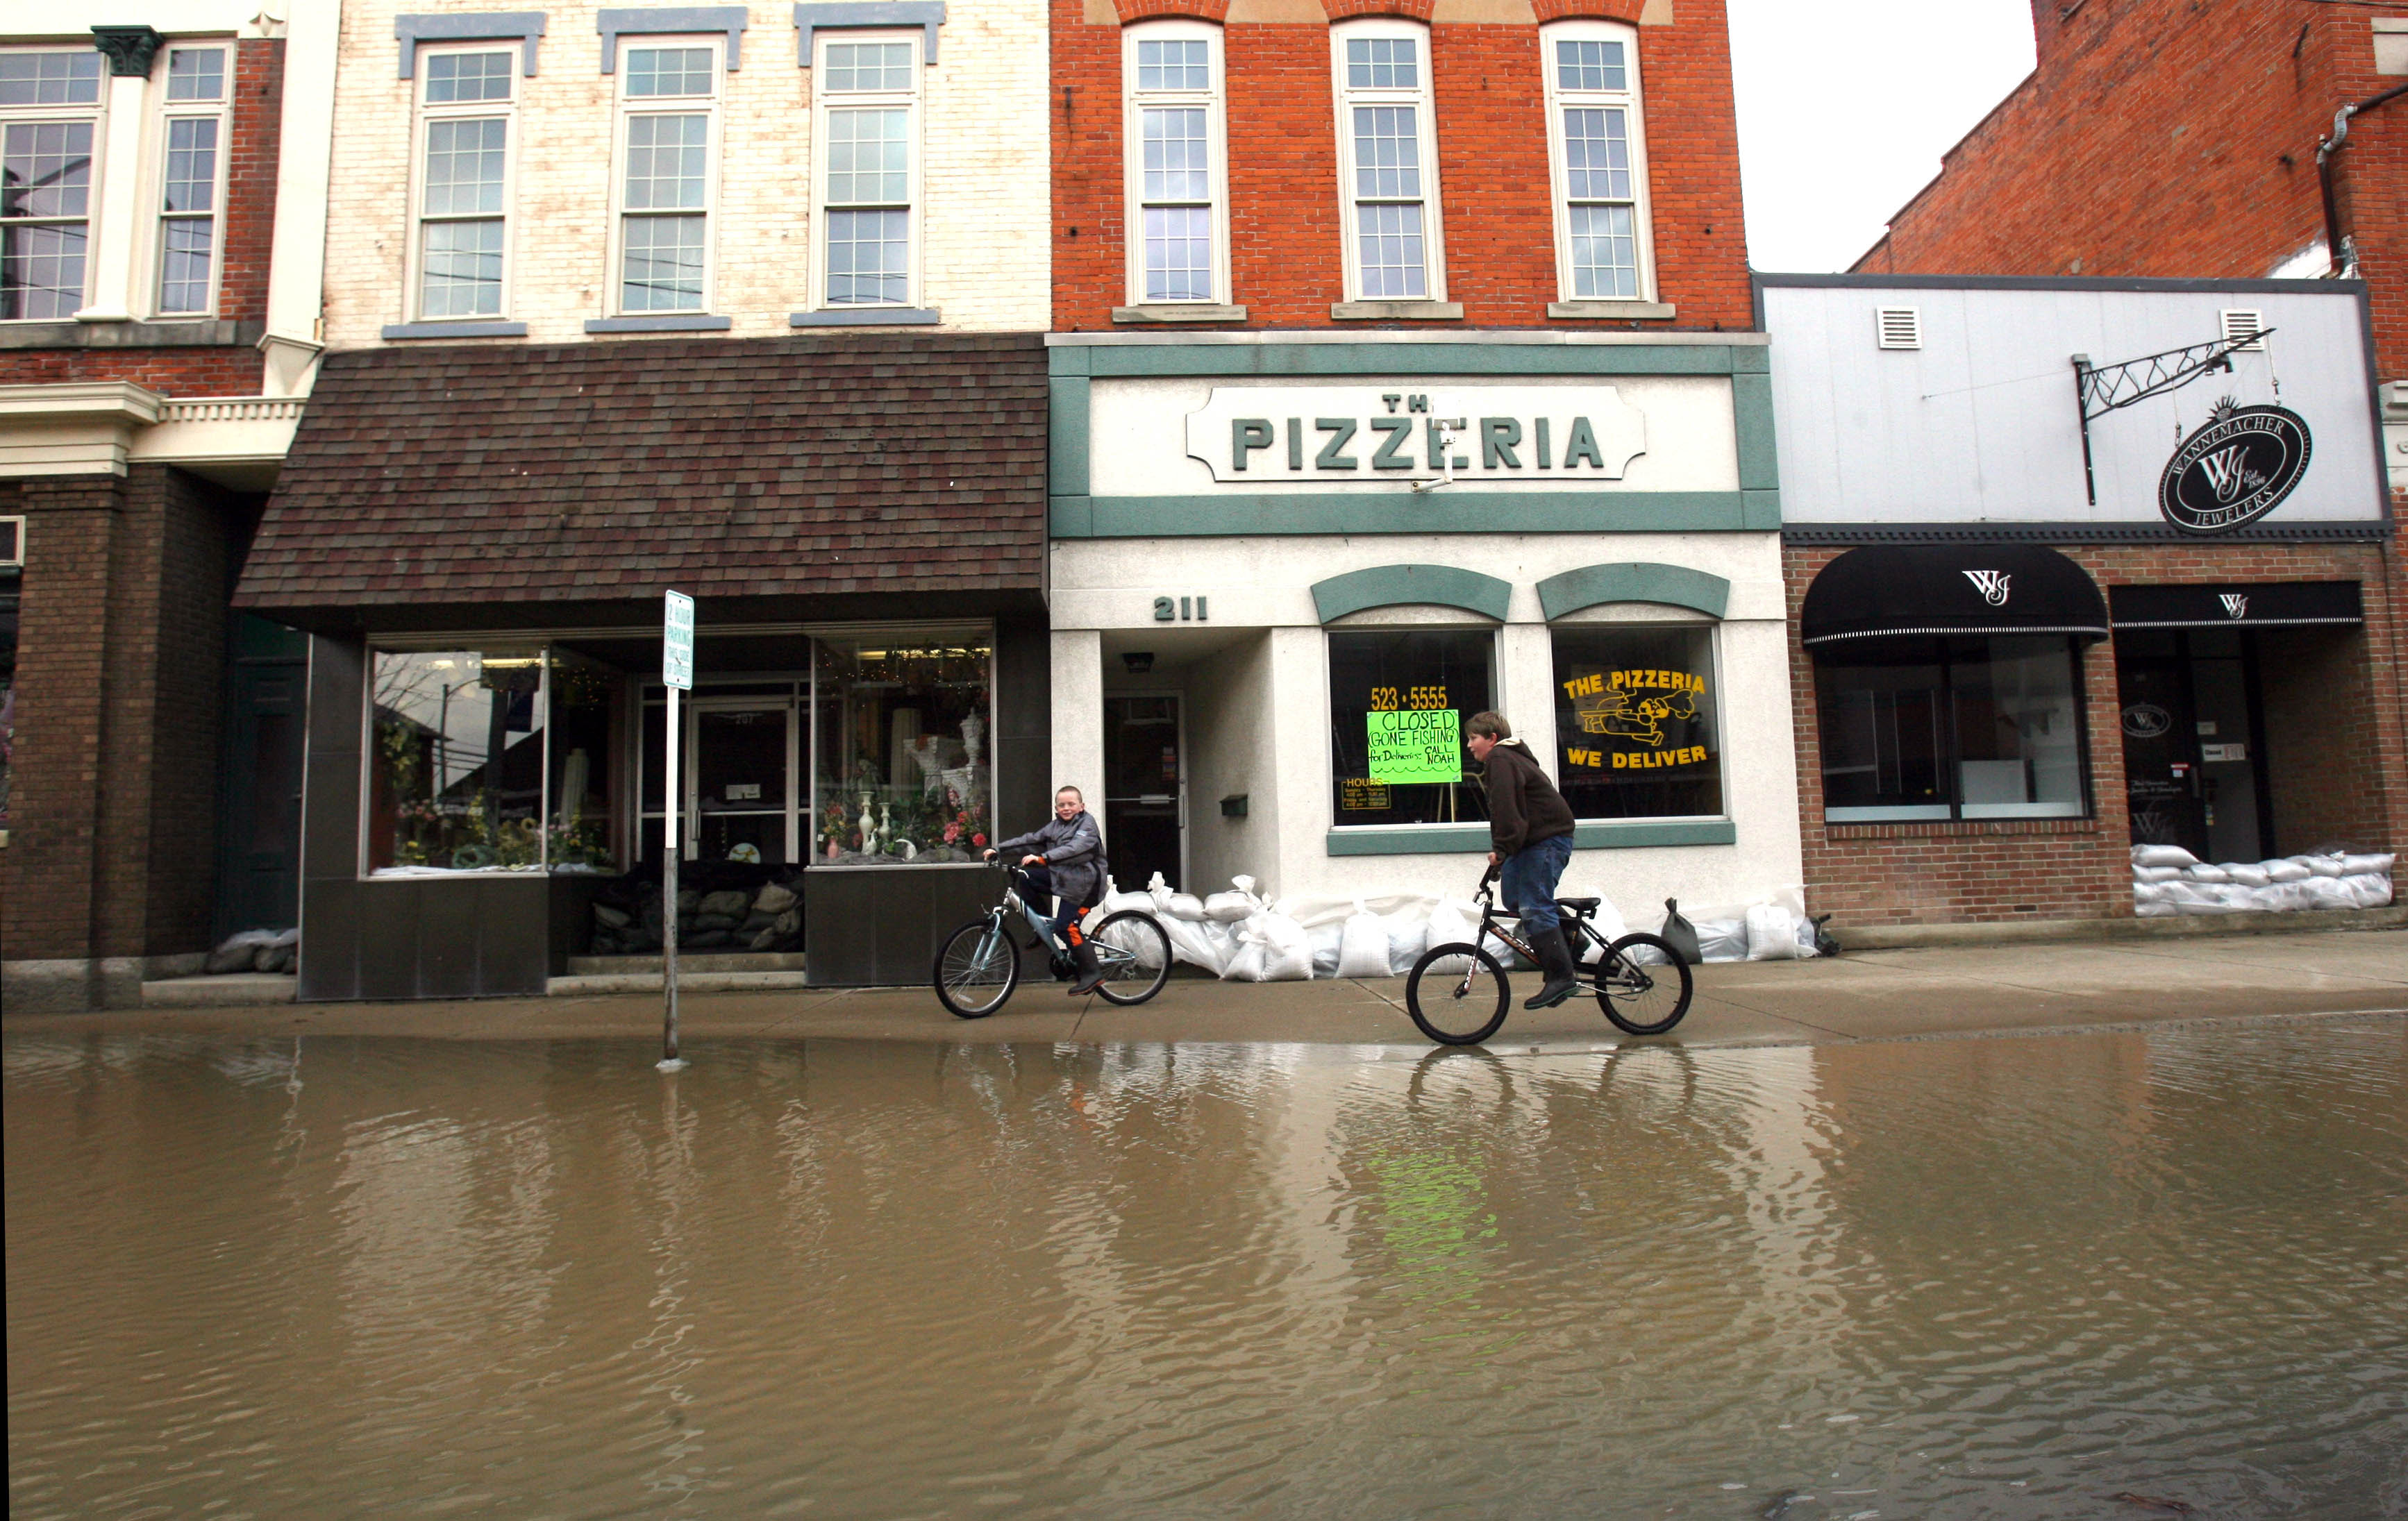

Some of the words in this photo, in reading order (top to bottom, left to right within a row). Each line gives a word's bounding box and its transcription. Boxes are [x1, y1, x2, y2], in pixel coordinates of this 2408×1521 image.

[1382, 394, 1433, 413] TH
[1232, 416, 1605, 472] PIZZERIA
[2173, 415, 2286, 476] WANNEMACHER
[2193, 486, 2274, 526] JEWELERS
[668, 603, 673, 621] 2
[1155, 596, 1207, 622] 211
[1563, 673, 1604, 700] THE
[1610, 669, 1706, 694] PIZZERIA
[1371, 687, 1398, 711] 523
[1410, 686, 1448, 709] 5555
[1382, 711, 1455, 731] CLOSED
[1368, 731, 1408, 748] (GONE
[1368, 749, 1384, 763] for
[1424, 744, 1455, 755] CALL
[1427, 753, 1455, 765] NOAH
[1566, 747, 1603, 767] WE
[1612, 745, 1708, 769] DELIVER
[1347, 778, 1384, 787] HOURS
